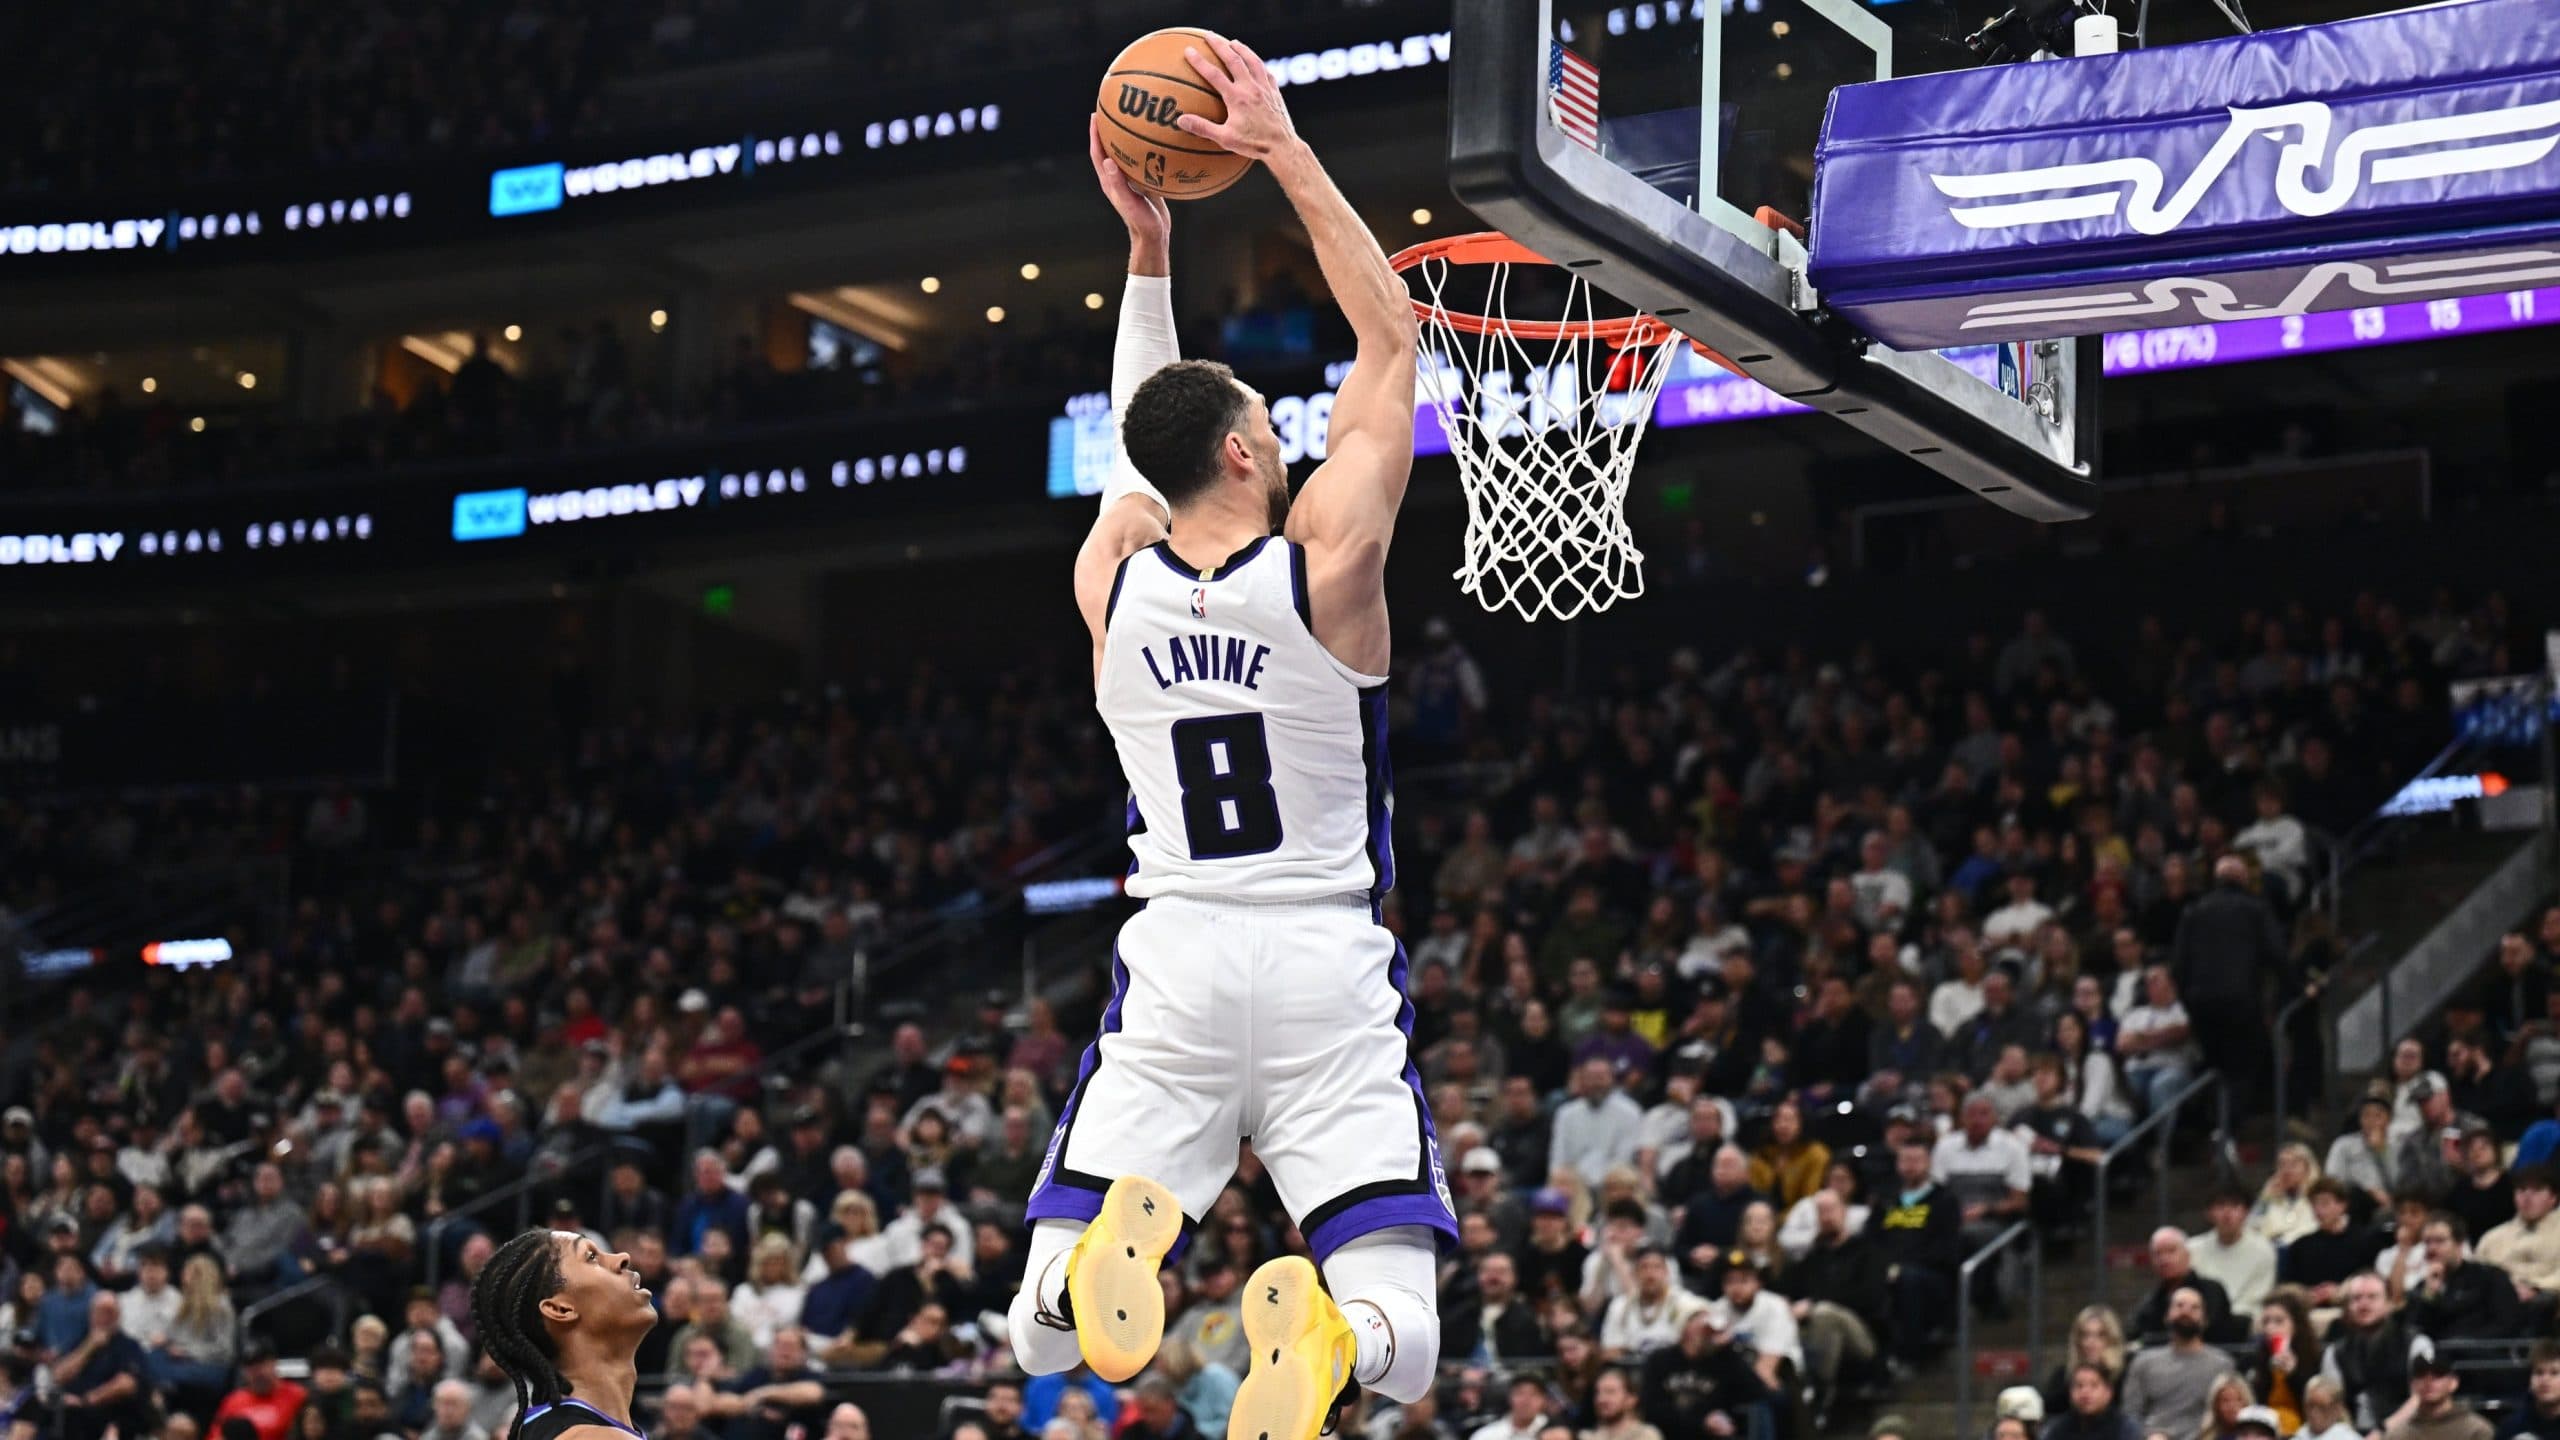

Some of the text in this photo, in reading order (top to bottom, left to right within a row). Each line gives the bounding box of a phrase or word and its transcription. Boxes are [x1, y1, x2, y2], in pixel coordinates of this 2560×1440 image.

[1119, 83, 1184, 131] Wil
[564, 143, 741, 197] WOODLEY
[527, 475, 705, 524] WOODLEY
[1141, 634, 1271, 690] LAVINE
[1171, 712, 1284, 860] 8
